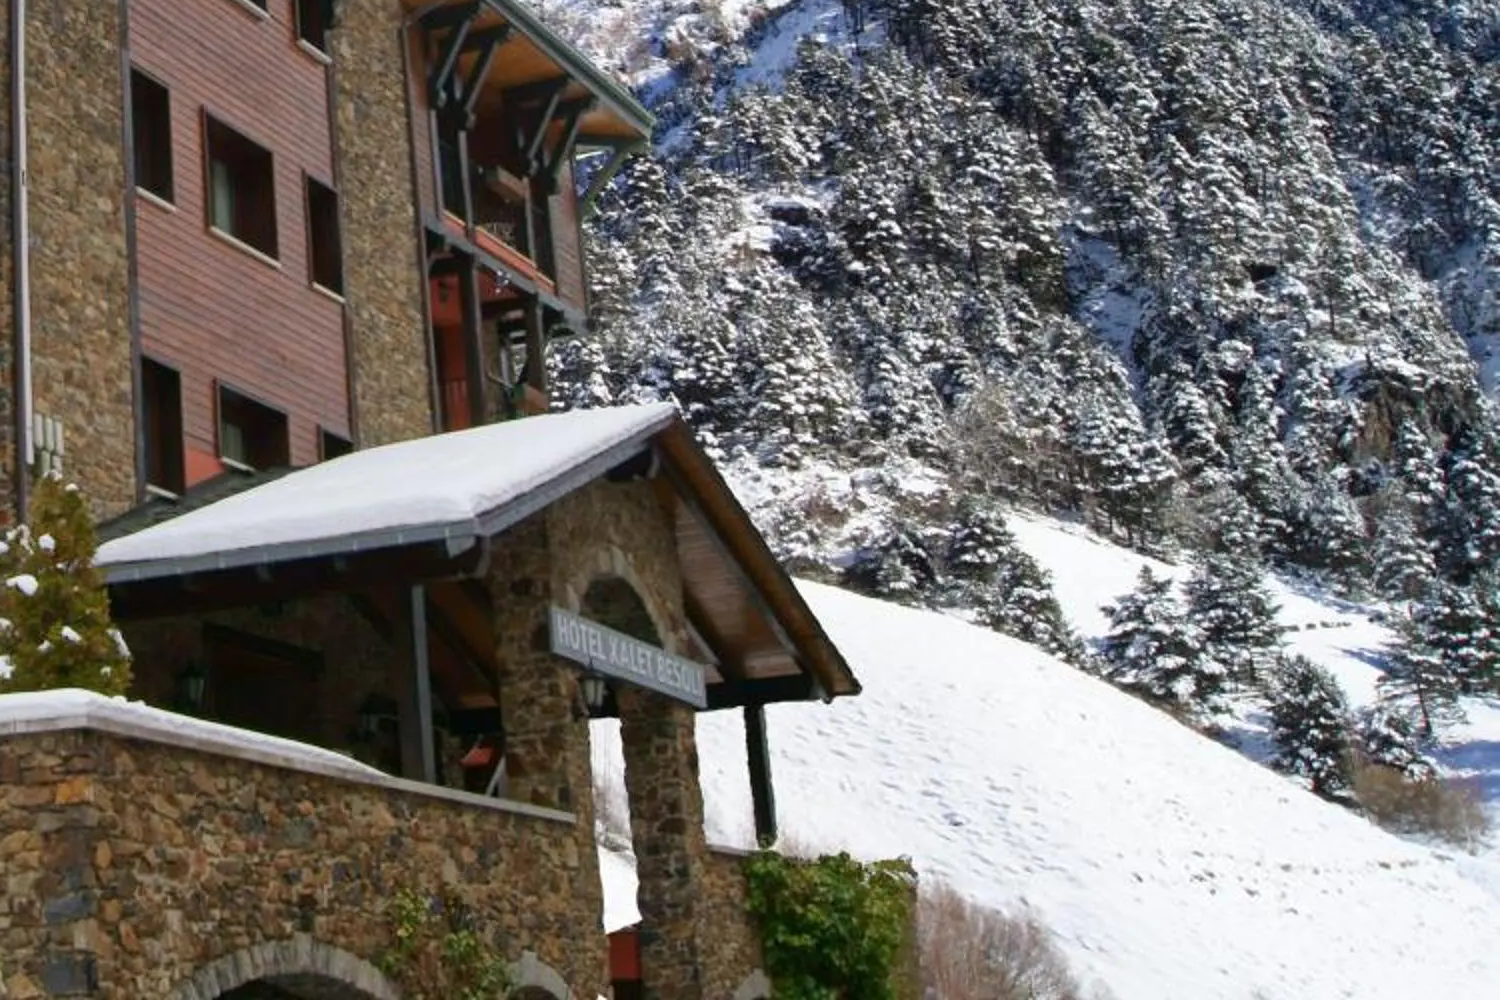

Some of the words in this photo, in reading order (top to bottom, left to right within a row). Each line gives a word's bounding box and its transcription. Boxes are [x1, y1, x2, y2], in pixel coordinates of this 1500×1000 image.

[556, 614, 606, 662] HOTEL
[608, 633, 654, 678] XALET
[657, 652, 703, 696] BESOLI
